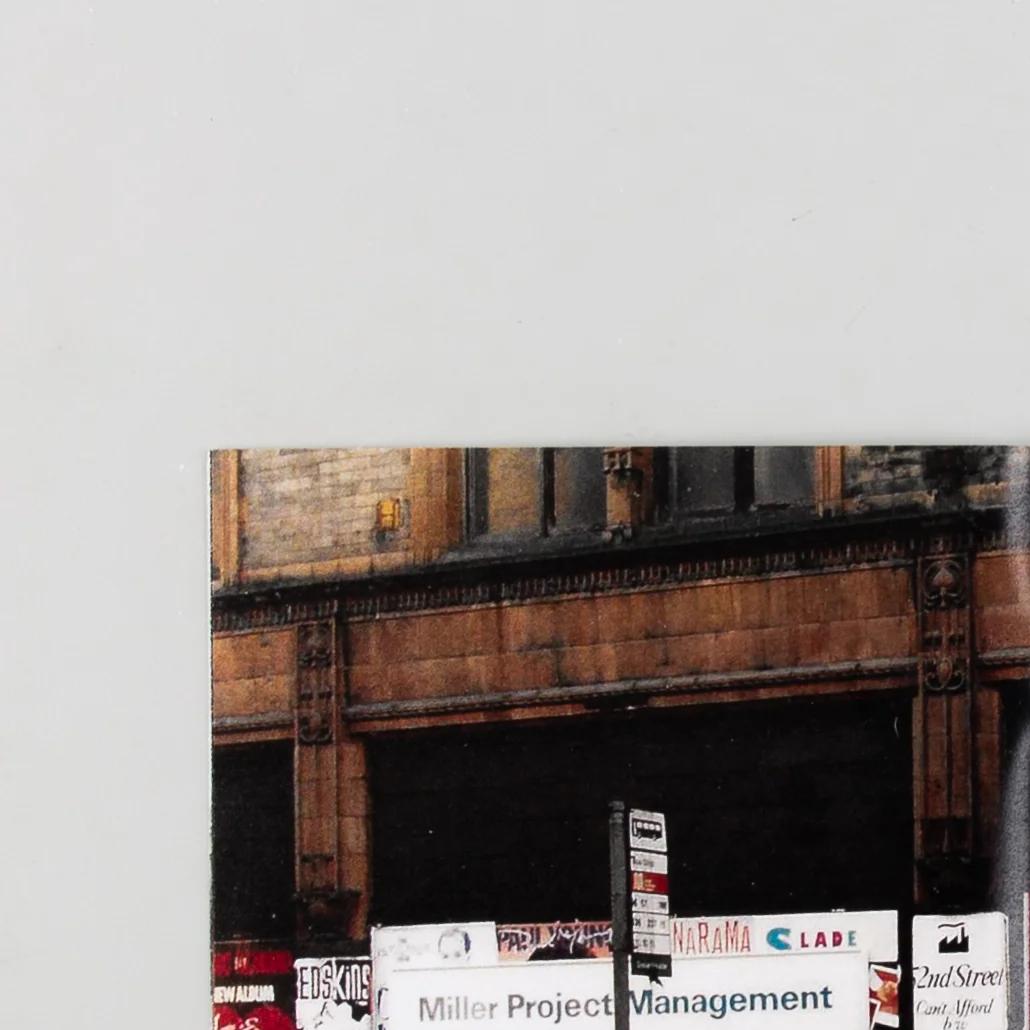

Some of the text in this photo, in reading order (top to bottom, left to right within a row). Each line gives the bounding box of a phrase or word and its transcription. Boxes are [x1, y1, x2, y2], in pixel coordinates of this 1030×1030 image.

[672, 920, 751, 956] NARAMA
[953, 963, 1004, 988] Street
[236, 985, 275, 1003] ALBUM
[419, 996, 498, 1021] Miller
[508, 993, 615, 1024] Project
[630, 986, 833, 1019] Management
